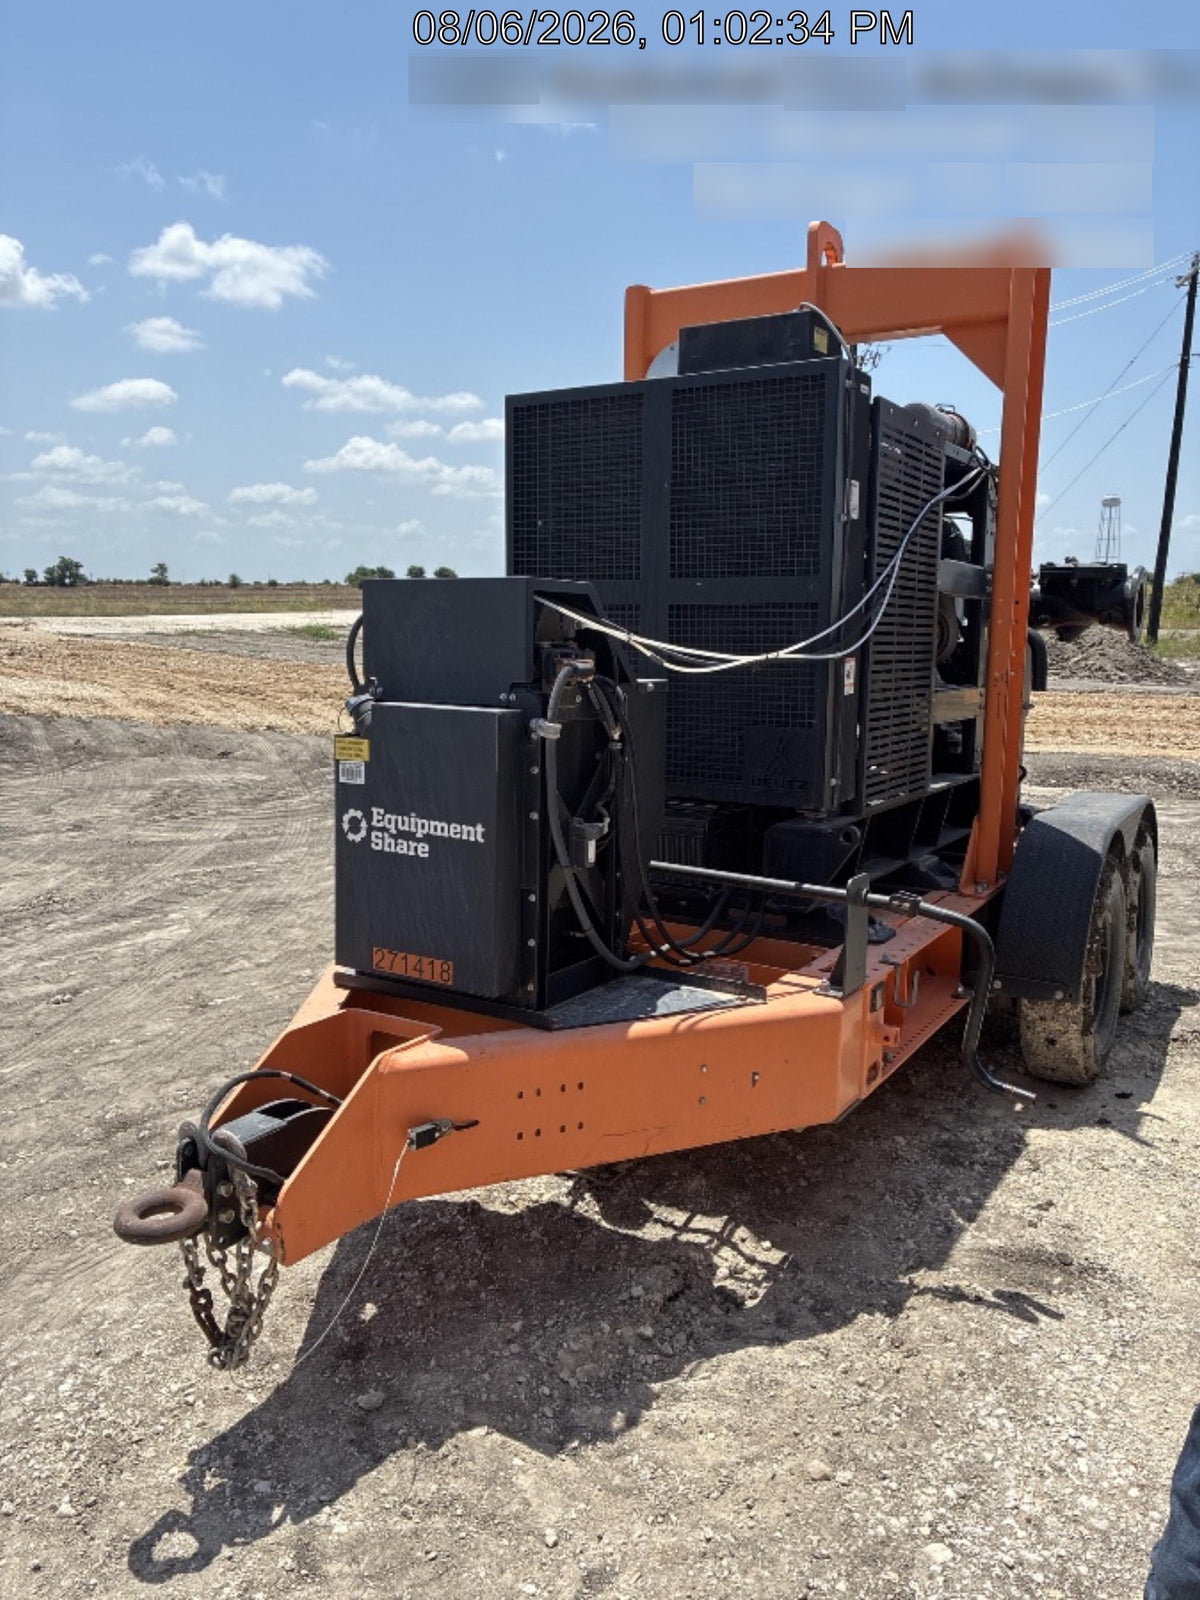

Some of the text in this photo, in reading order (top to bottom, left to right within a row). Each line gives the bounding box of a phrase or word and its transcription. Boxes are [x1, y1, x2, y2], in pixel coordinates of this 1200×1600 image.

[371, 807, 485, 843] Equipment
[370, 831, 429, 857] Share
[373, 949, 451, 983] 271418
